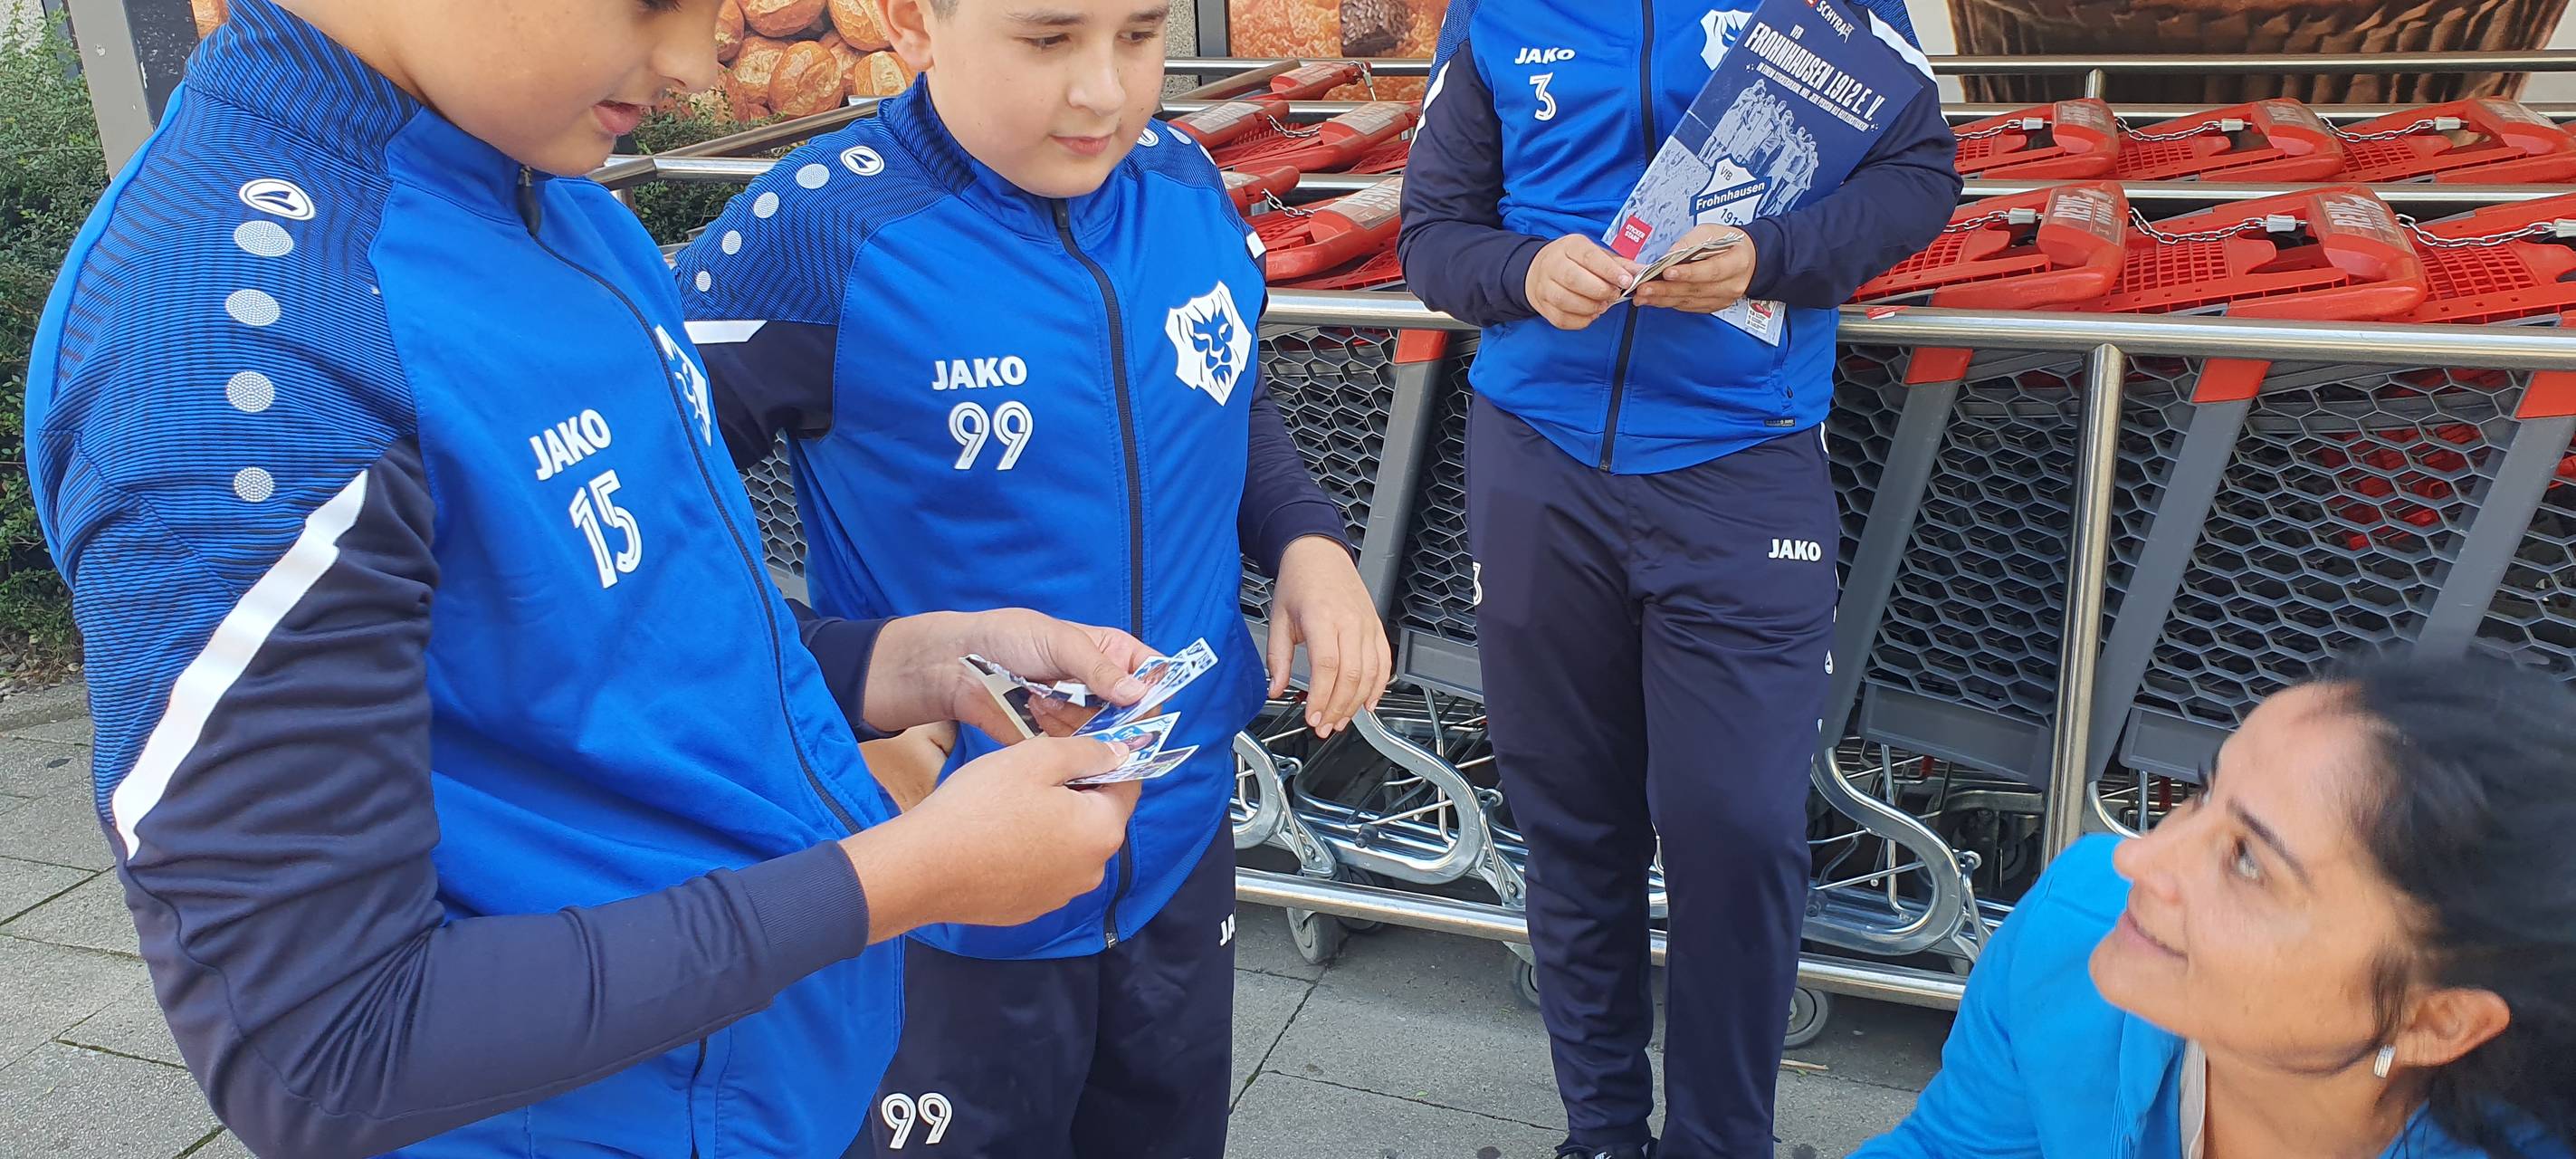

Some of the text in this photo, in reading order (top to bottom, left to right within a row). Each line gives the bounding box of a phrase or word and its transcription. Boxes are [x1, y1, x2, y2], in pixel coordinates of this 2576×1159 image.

[1514, 47, 1576, 65] JAKO
[1744, 22, 1836, 91] FROHNHAUSEN
[1824, 71, 1863, 108] 1912
[1529, 72, 1557, 121] 3
[1720, 166, 1733, 181] VfB
[1695, 182, 1766, 211] Frohnhausen
[931, 355, 1027, 390] JAKO
[529, 408, 612, 481] JAKO
[948, 400, 1034, 471] 99
[568, 469, 643, 589] 15
[1768, 538, 1822, 561] JAKO
[1219, 908, 1236, 946] JA
[881, 1092, 953, 1150] 99
